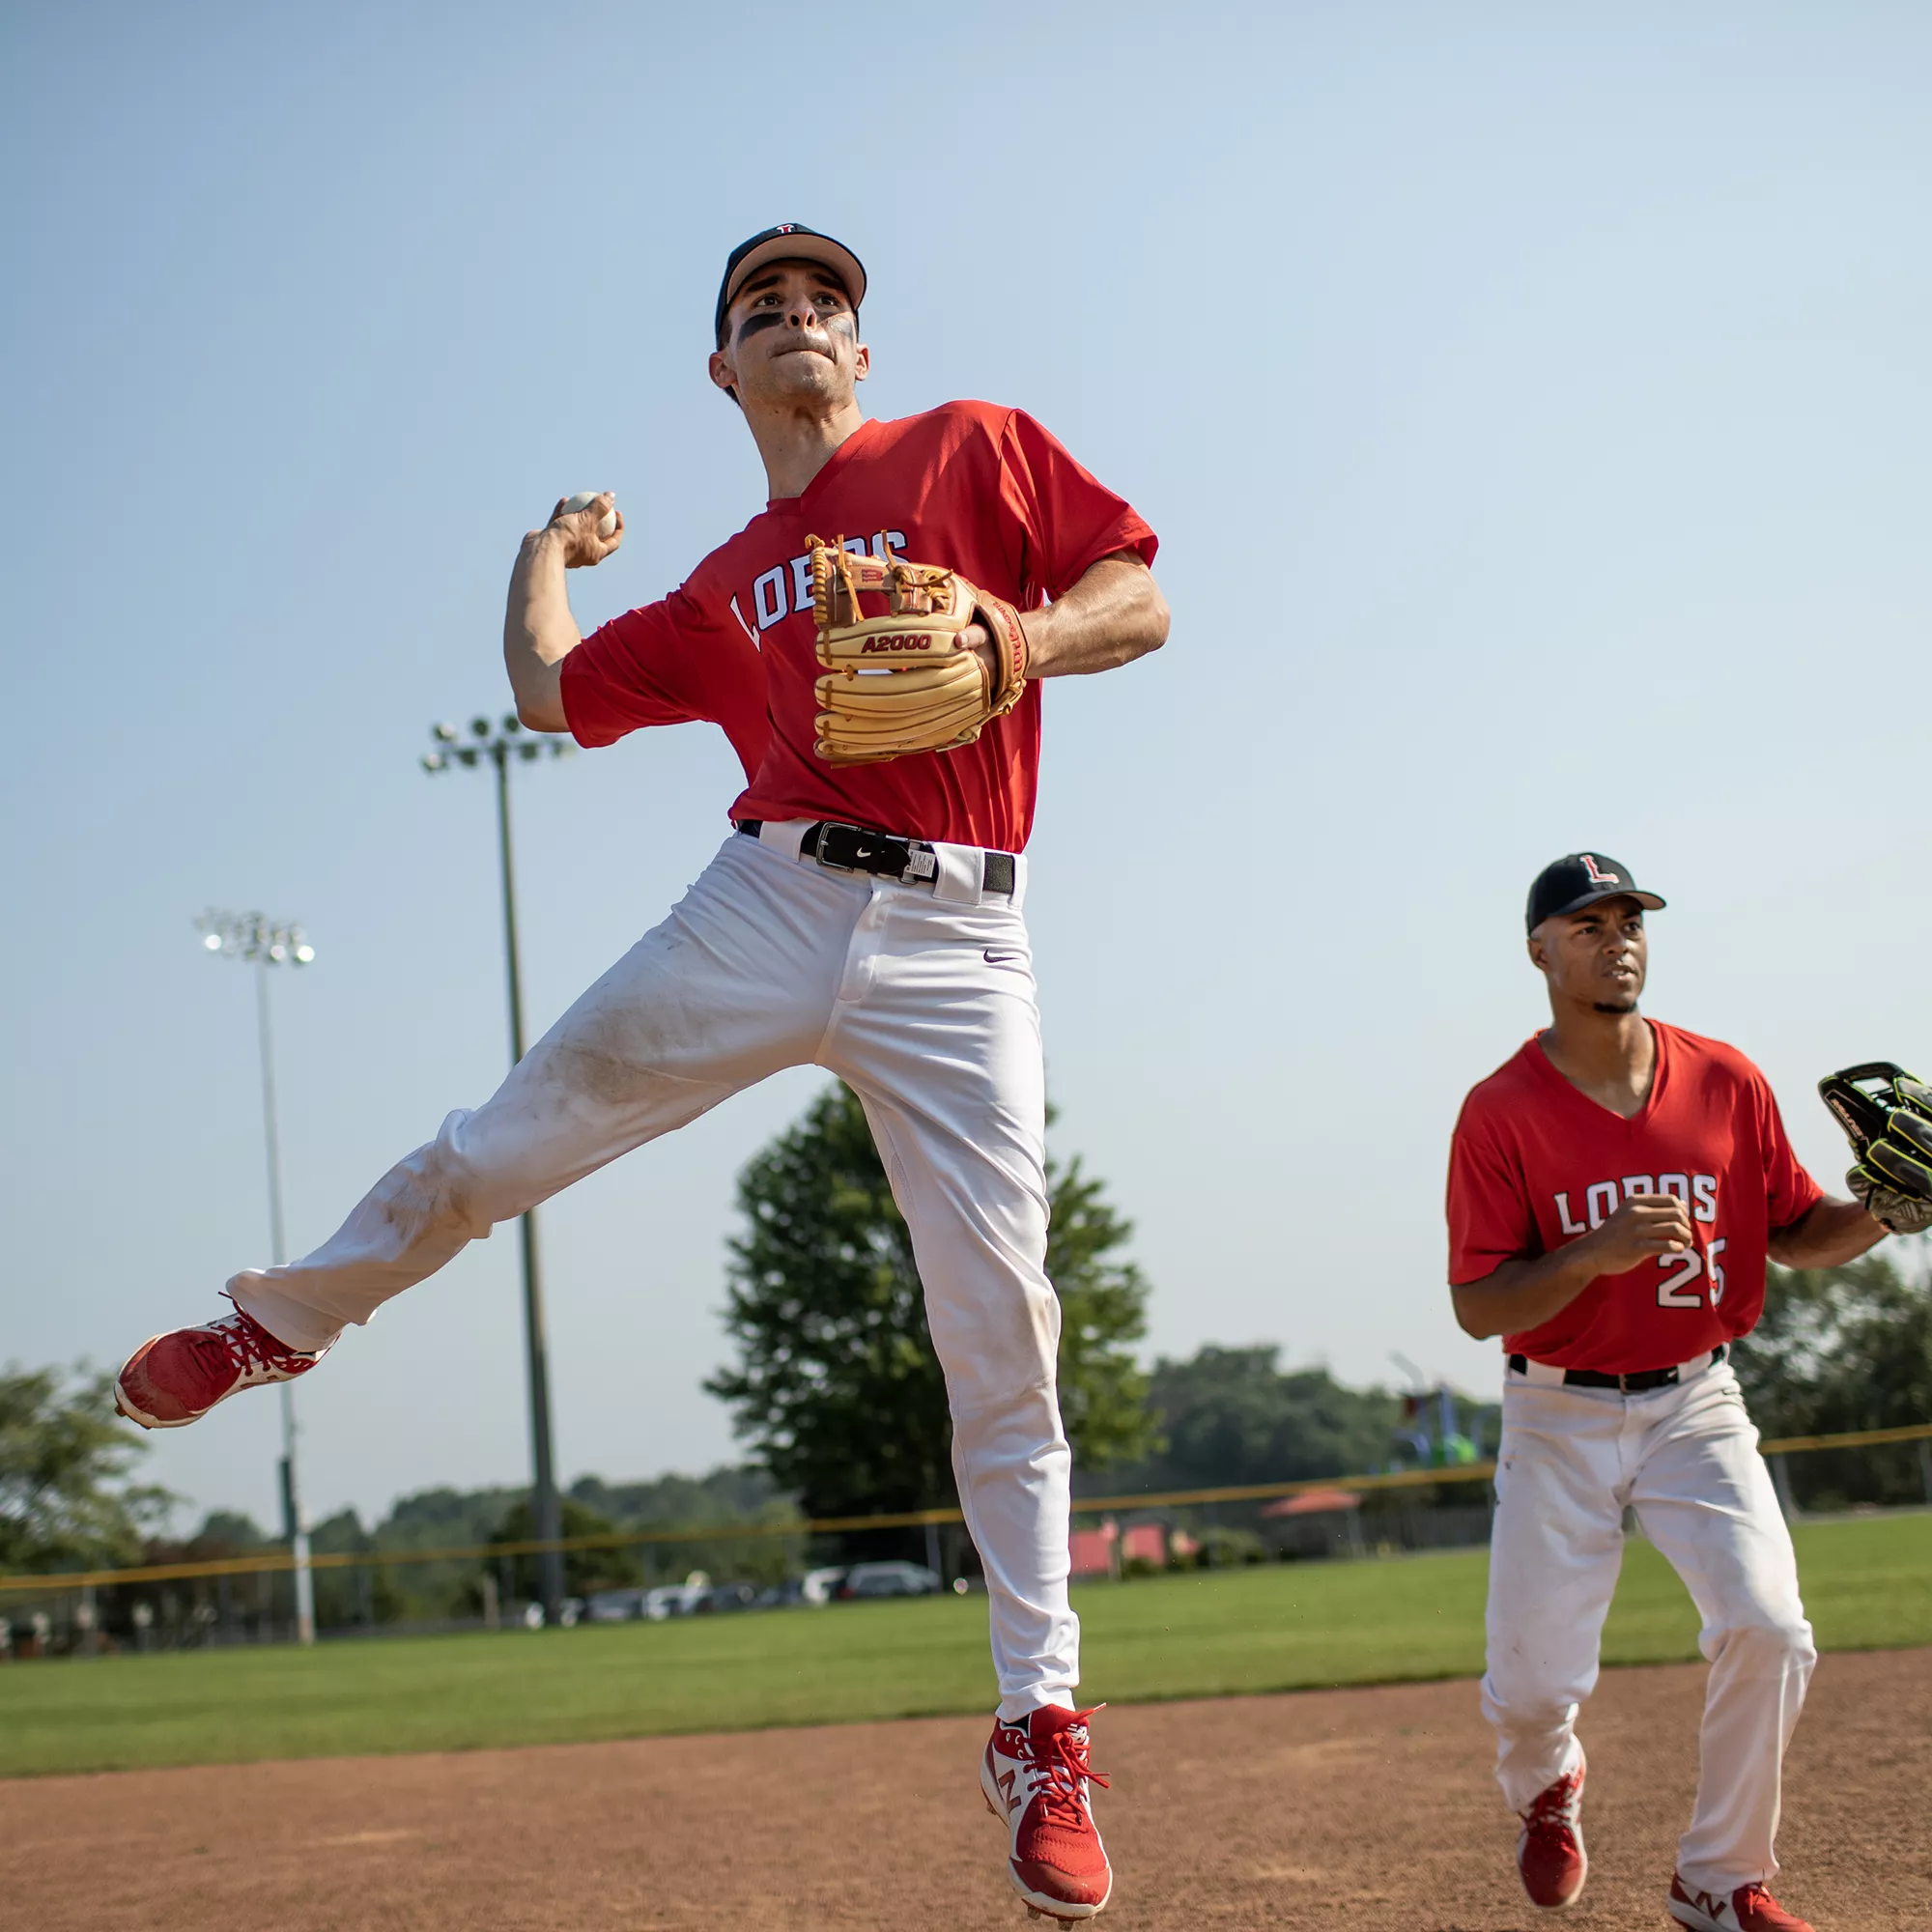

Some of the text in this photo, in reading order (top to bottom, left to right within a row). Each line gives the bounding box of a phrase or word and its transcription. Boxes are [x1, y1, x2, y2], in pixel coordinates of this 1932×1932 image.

[861, 634, 933, 654] A2000
[1579, 854, 1620, 884] L
[1657, 1237, 1727, 1309] 25
